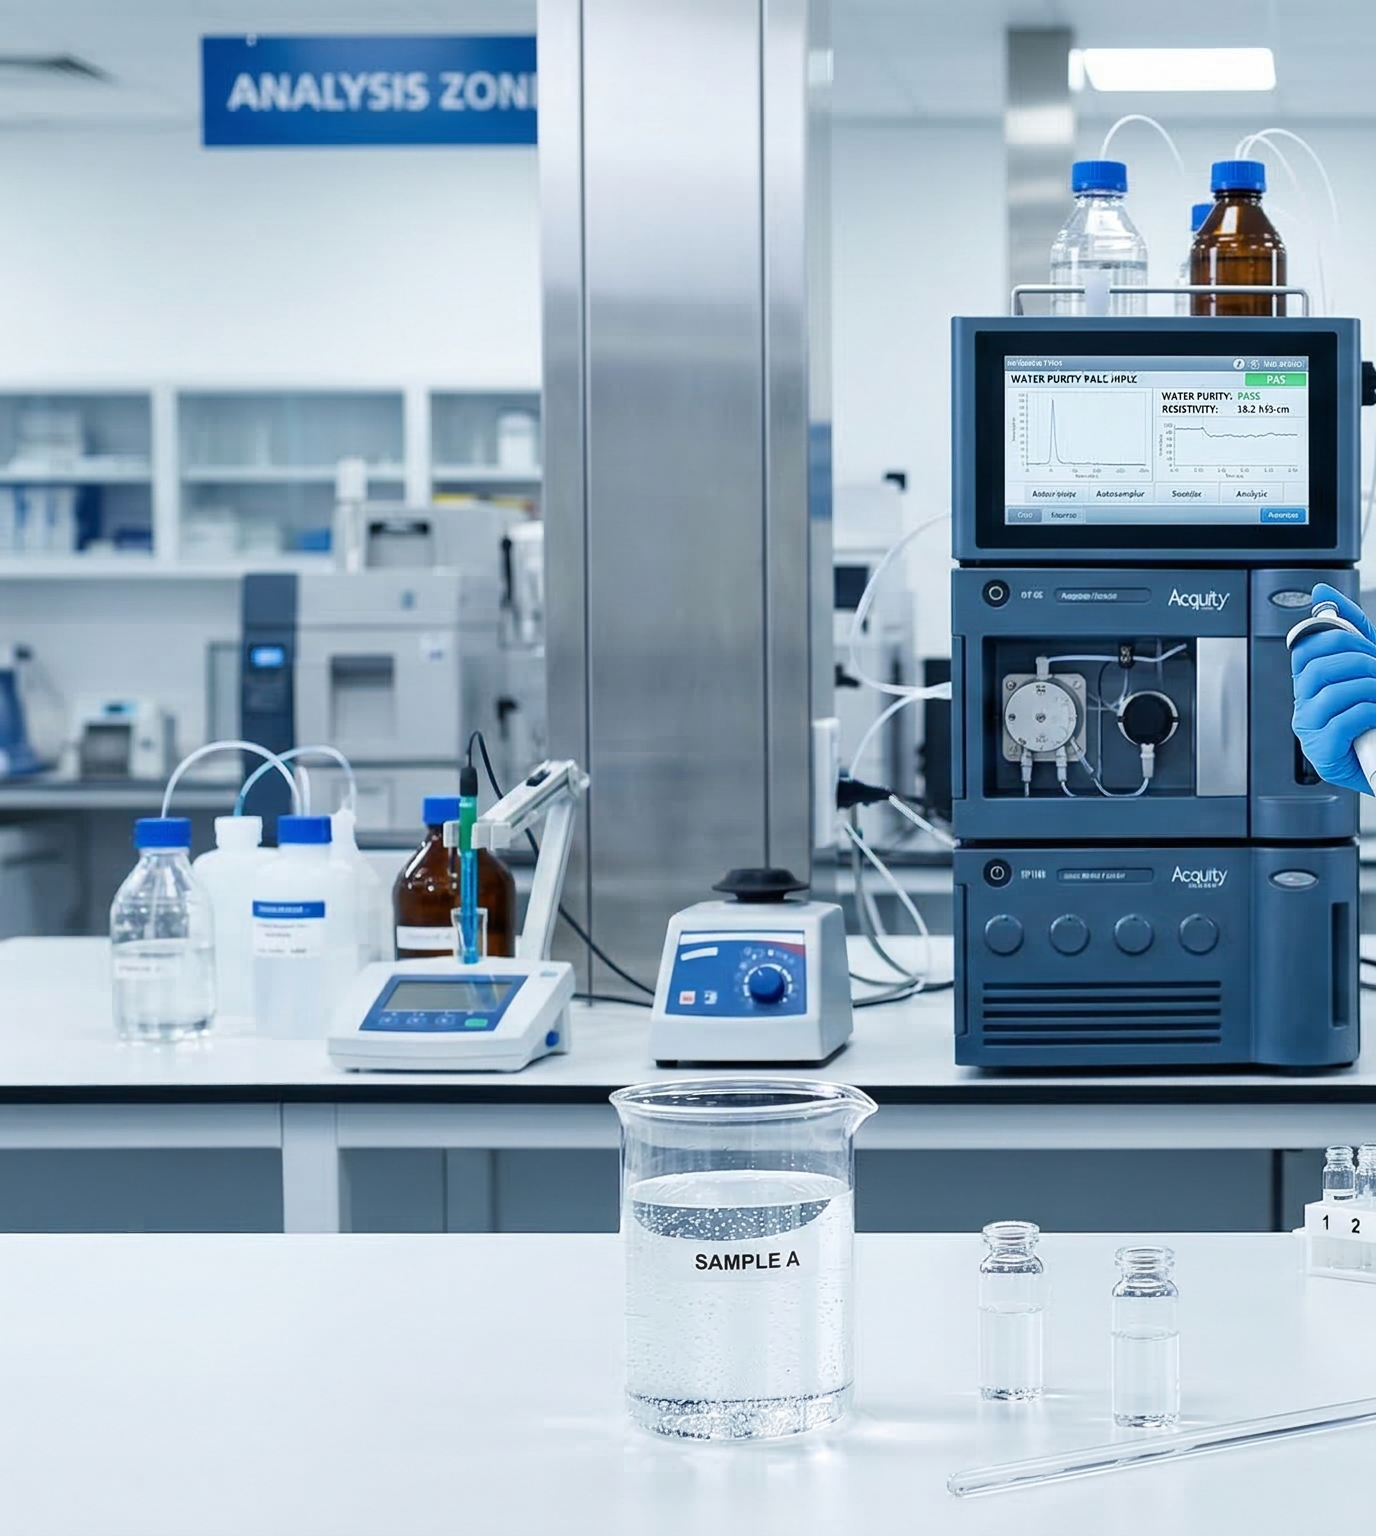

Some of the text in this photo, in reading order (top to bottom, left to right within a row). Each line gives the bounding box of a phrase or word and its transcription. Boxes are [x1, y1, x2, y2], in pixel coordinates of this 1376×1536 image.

[227, 70, 431, 112] ANALYSIS
[1010, 374, 1046, 384] WATER
[1266, 375, 1287, 385] PAS
[1161, 391, 1195, 401] WATER
[1237, 391, 1261, 401] PASS
[1167, 588, 1231, 611] Acquity
[1171, 865, 1228, 888] Acquity
[1322, 1214, 1329, 1231] 1
[1351, 1217, 1361, 1234] 2
[695, 1250, 800, 1271] SAMPLE A
